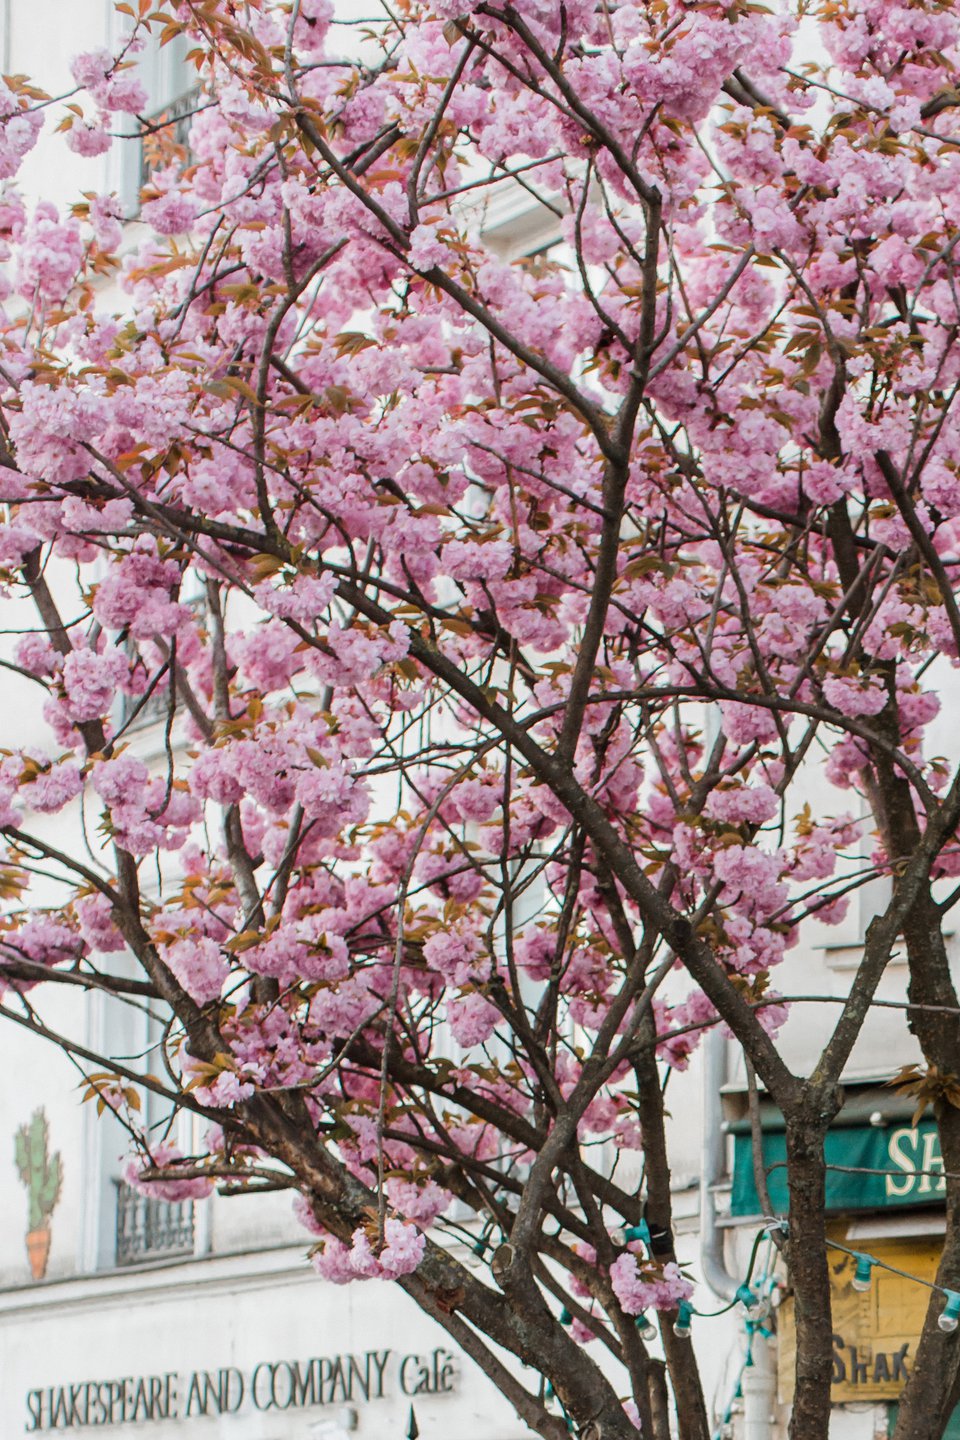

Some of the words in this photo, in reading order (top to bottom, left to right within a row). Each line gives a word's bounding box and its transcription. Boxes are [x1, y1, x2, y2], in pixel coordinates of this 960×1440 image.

[25, 1371, 178, 1433] SHAKESPEARE
[185, 1366, 245, 1418] AND
[252, 1348, 392, 1412] COMPANY
[400, 1346, 456, 1397] Café
